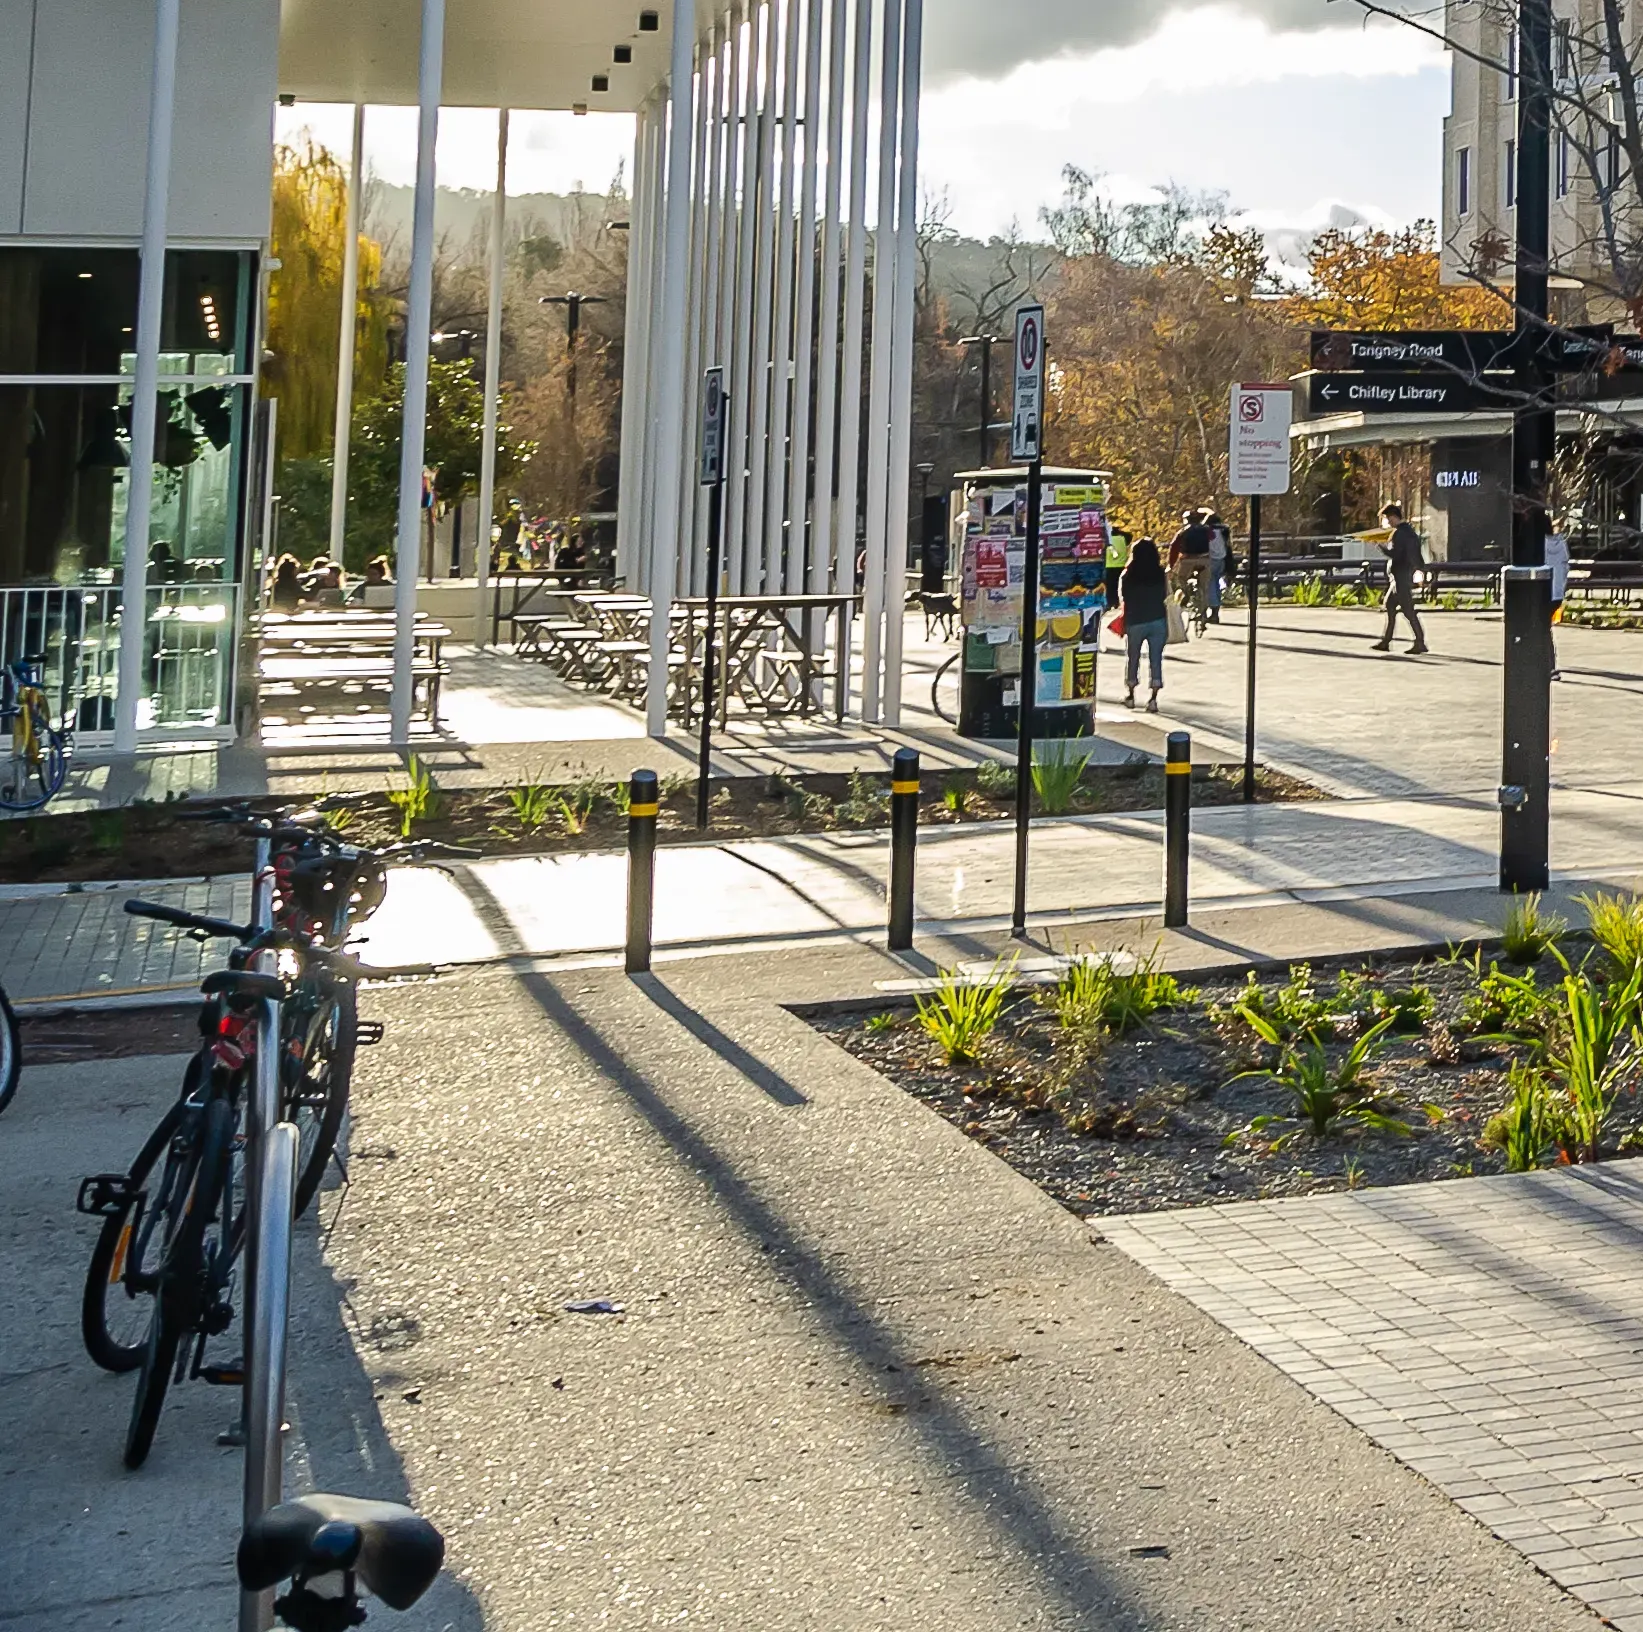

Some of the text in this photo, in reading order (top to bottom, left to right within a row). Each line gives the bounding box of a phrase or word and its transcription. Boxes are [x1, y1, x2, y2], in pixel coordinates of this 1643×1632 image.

[1351, 341, 1444, 359] Tangney Road
[1349, 385, 1447, 402] Chifley Library
